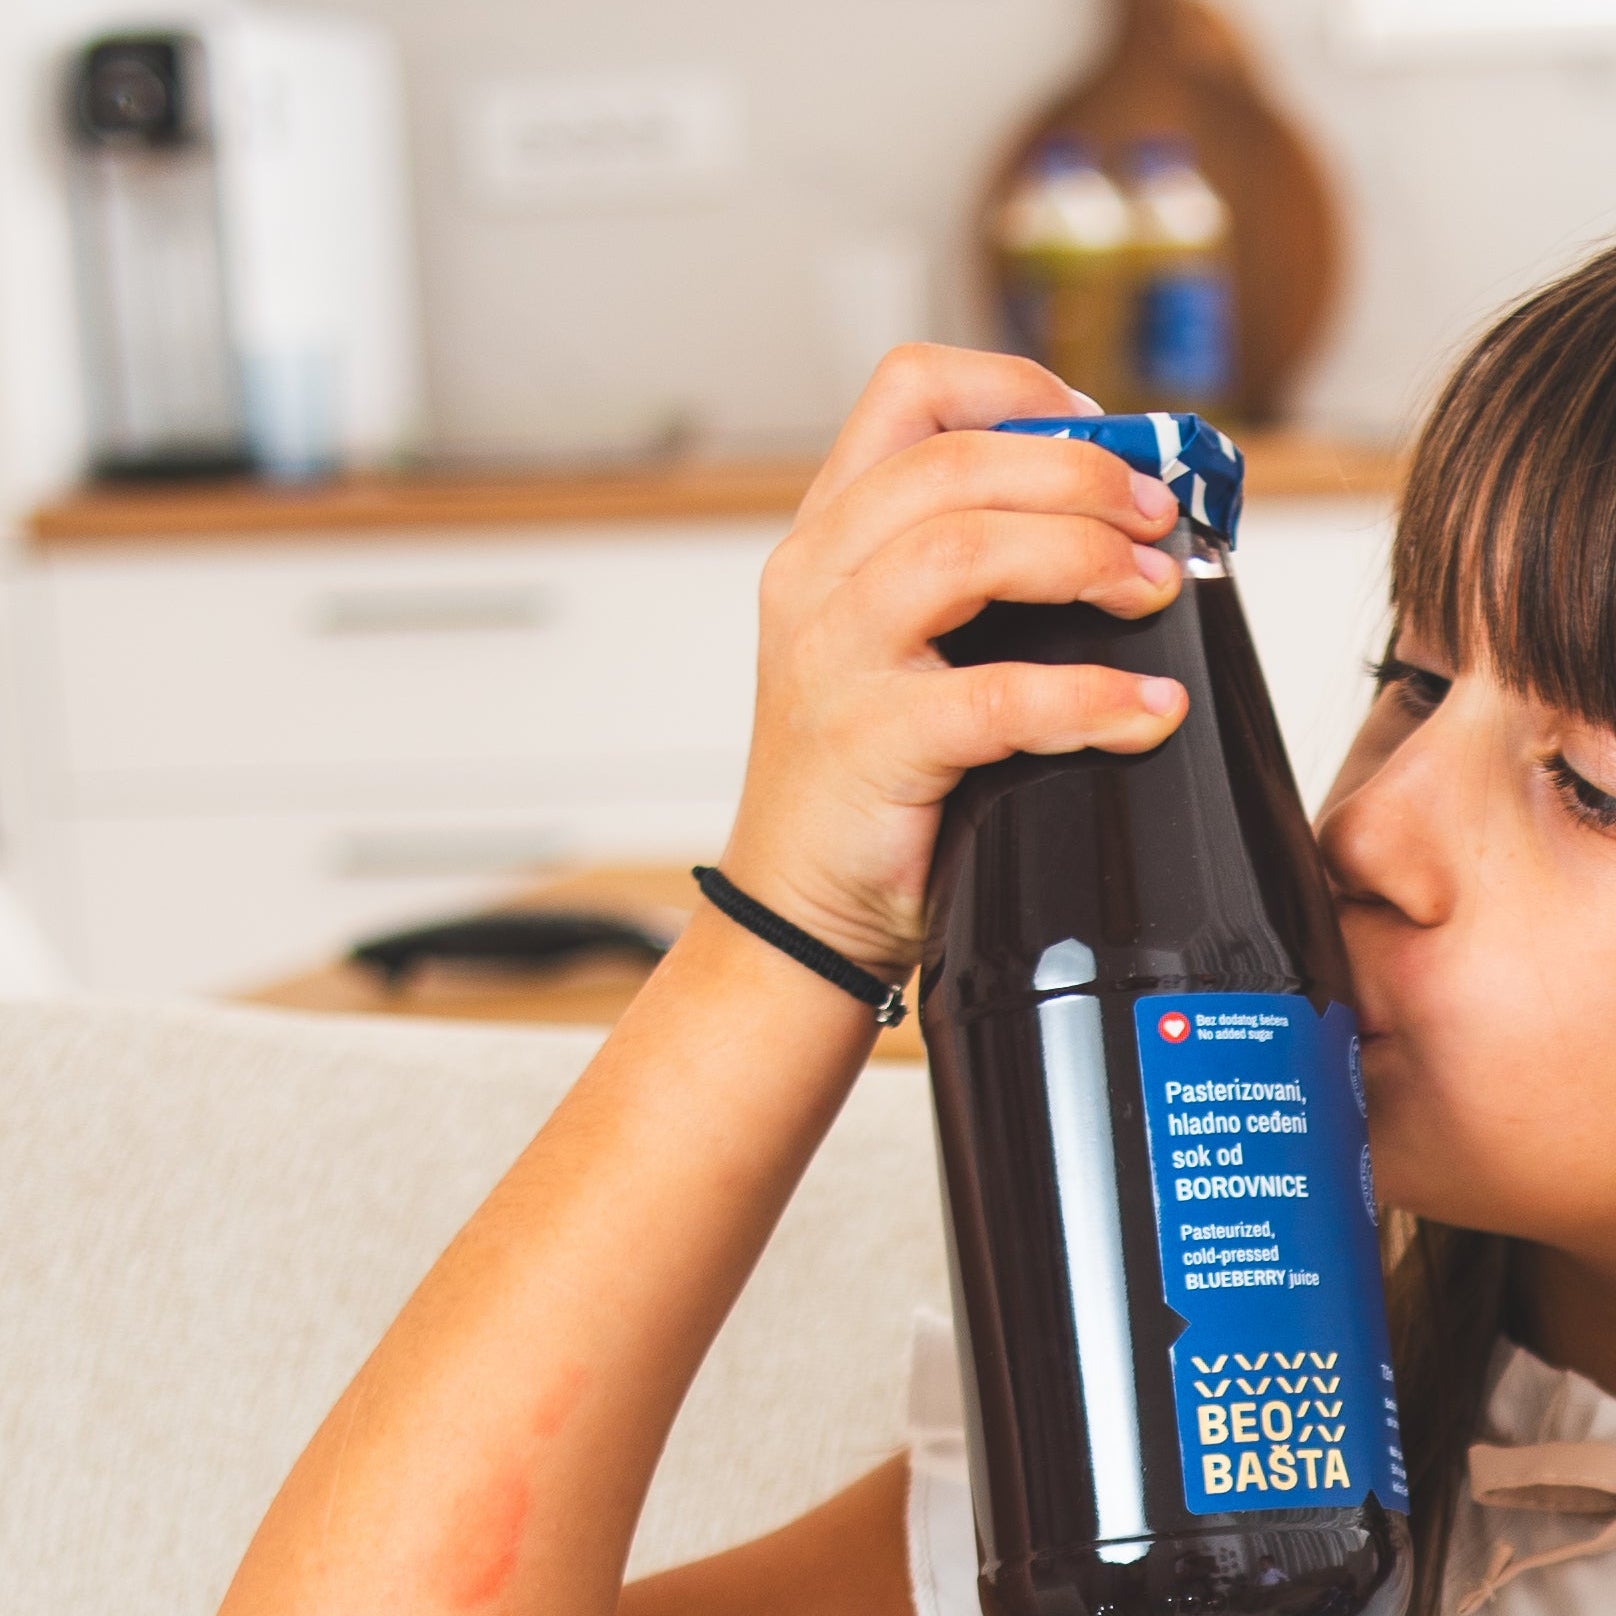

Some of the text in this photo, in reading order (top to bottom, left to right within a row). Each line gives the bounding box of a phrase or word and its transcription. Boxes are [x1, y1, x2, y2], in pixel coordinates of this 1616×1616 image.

[1198, 1028, 1274, 1042] No added sugar
[1165, 1078, 1307, 1105] Pasterizovani,
[1168, 1110, 1308, 1136] hladno ceđeni
[1172, 1143, 1243, 1169] sok od
[1175, 1176, 1309, 1201] BOROVNICE
[1180, 1221, 1276, 1241] Pasteurized,
[1183, 1245, 1279, 1266] cold-pressed
[1185, 1269, 1320, 1290] BLUEBERRY juice
[1197, 1400, 1293, 1445] BEO
[1202, 1445, 1351, 1495] BAŠTA
